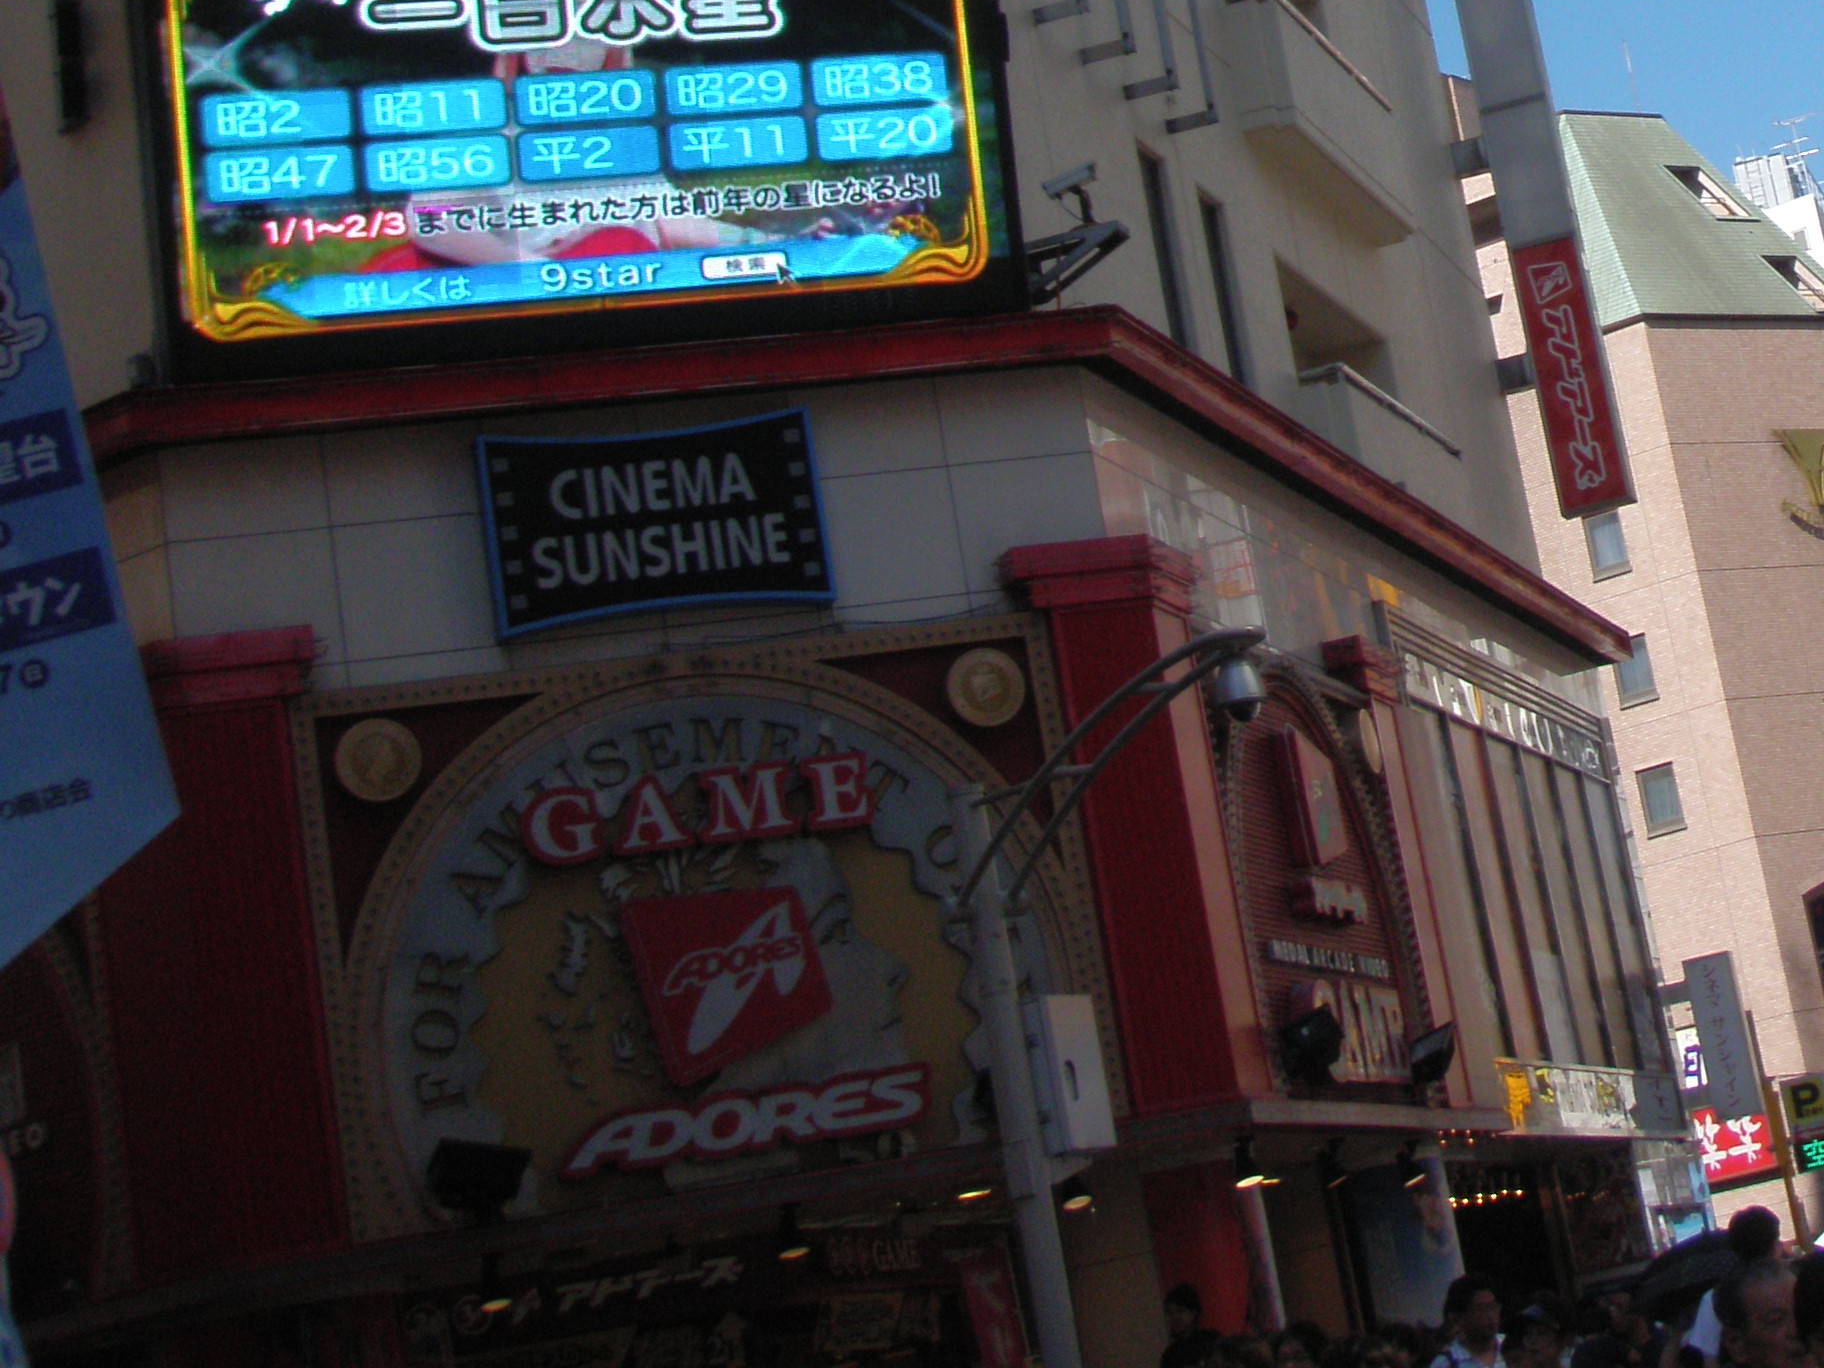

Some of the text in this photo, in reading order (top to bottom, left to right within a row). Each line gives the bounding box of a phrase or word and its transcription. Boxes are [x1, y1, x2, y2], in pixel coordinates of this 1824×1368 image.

[216, 57, 934, 139] 昭2 昭11 昭20 昭29 昭38
[220, 114, 940, 196] 昭47 昭56 平2 平11 平20
[344, 255, 772, 311] 詳しくは 9star 検索
[549, 452, 757, 520] CINEMA
[531, 512, 793, 590] SUNSHINE
[0, 575, 84, 630] ウン
[529, 758, 870, 858] GAME
[663, 935, 805, 997] ADORES
[412, 951, 471, 1118] FOR
[568, 1068, 927, 1173] ADORES
[1791, 1082, 1821, 1120] P
